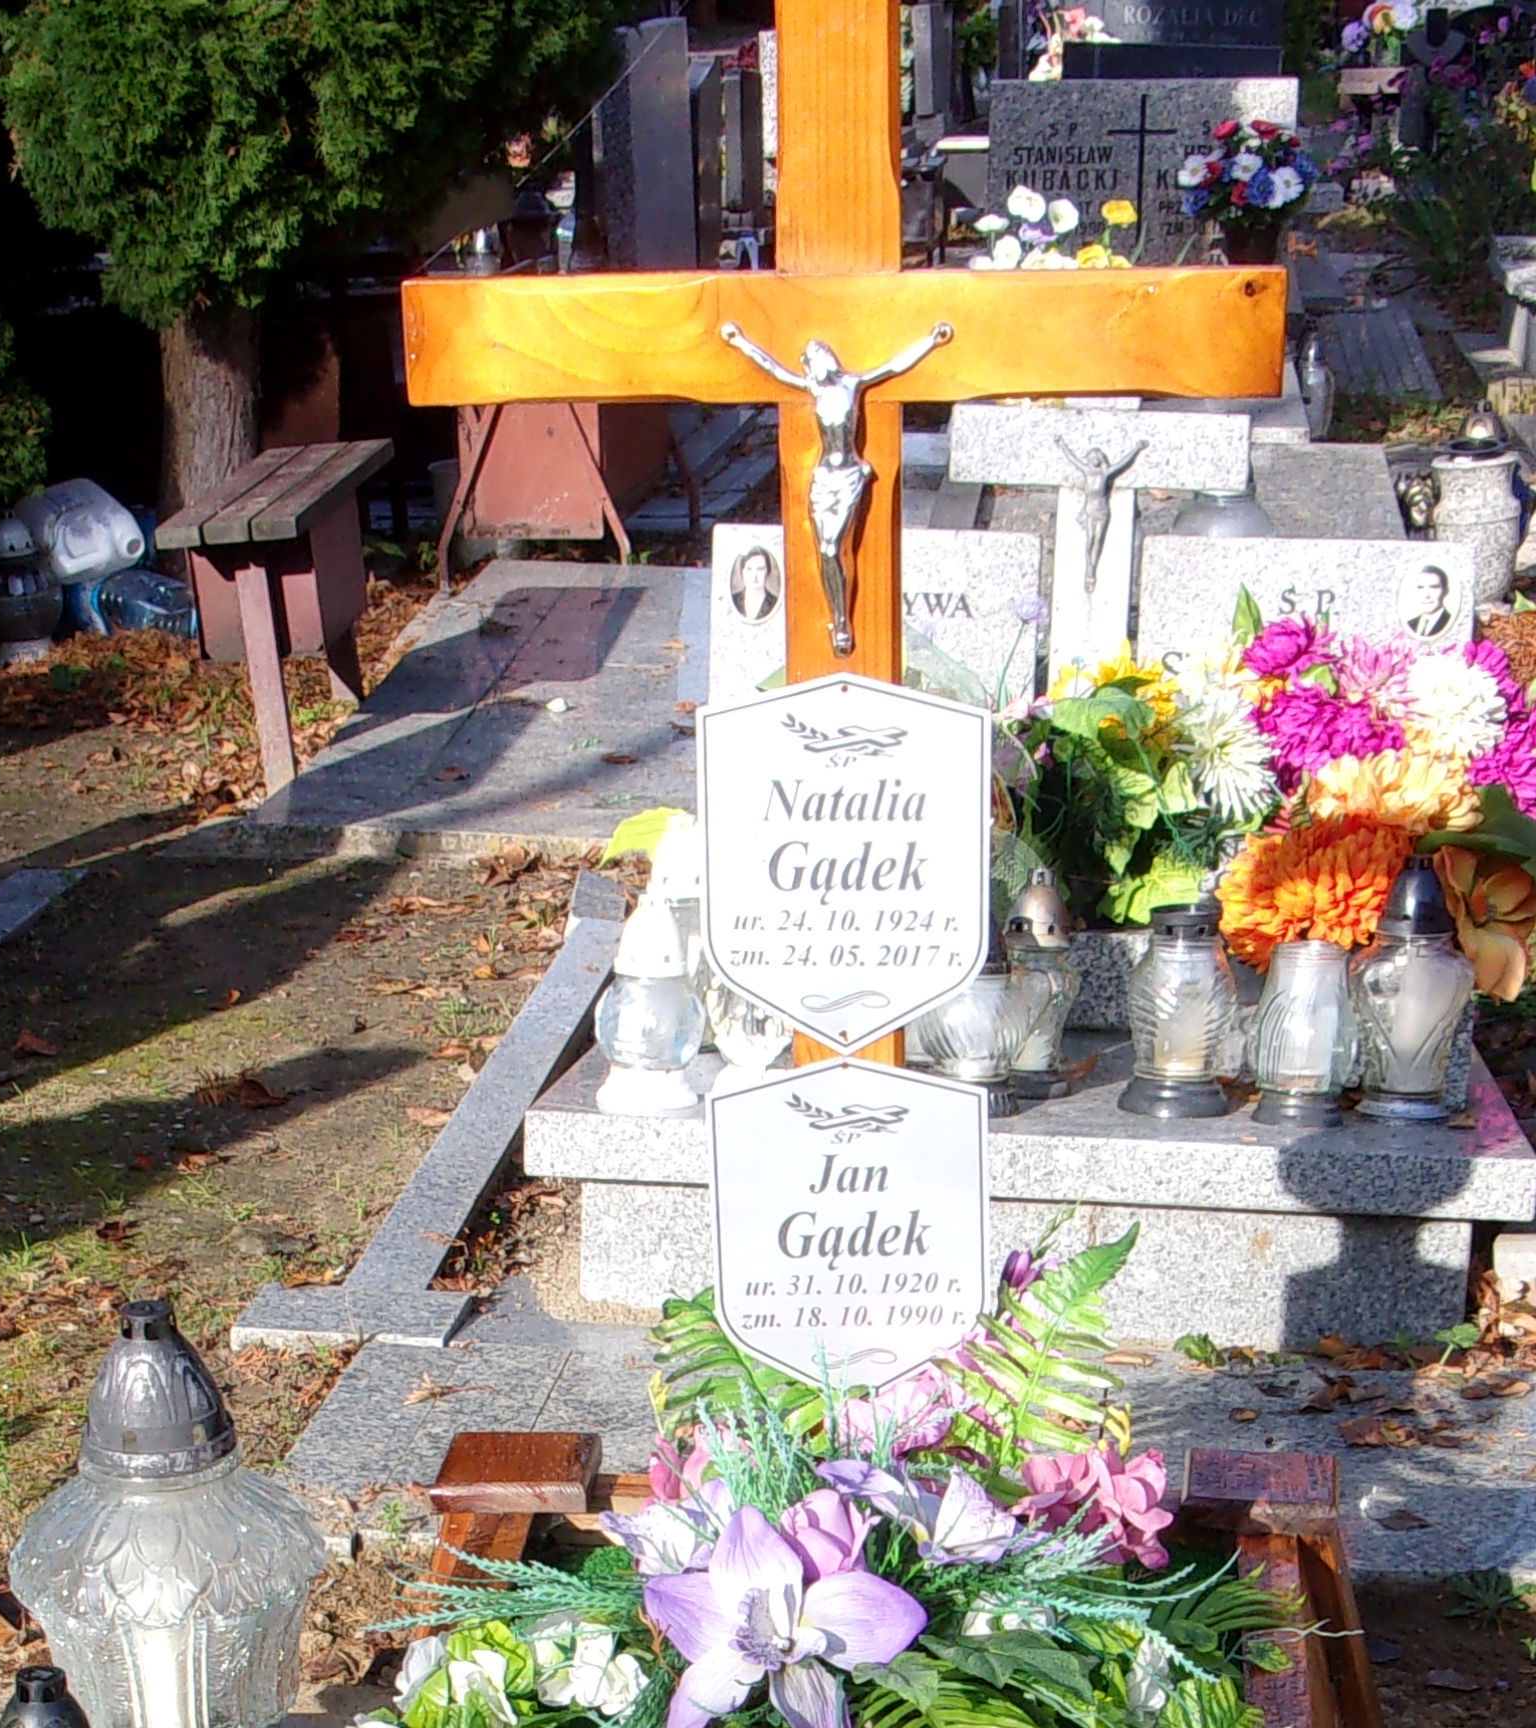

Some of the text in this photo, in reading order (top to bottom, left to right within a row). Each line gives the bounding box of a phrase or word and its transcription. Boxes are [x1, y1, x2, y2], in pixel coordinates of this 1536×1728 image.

[1013, 145, 1114, 166] STANISŁAW
[763, 778, 927, 823] Natalia
[767, 840, 929, 906] Gądek
[732, 909, 959, 932] ur. 24. 10. 1924 r.
[728, 944, 963, 967] zm. 24. 05. 2017 r.
[808, 1153, 890, 1195] Jan
[777, 1208, 933, 1272] Gądek
[745, 1272, 962, 1297] ur. 31. 10. 1920 r.
[741, 1304, 966, 1330] zm. 18. 10. 1990 r.
